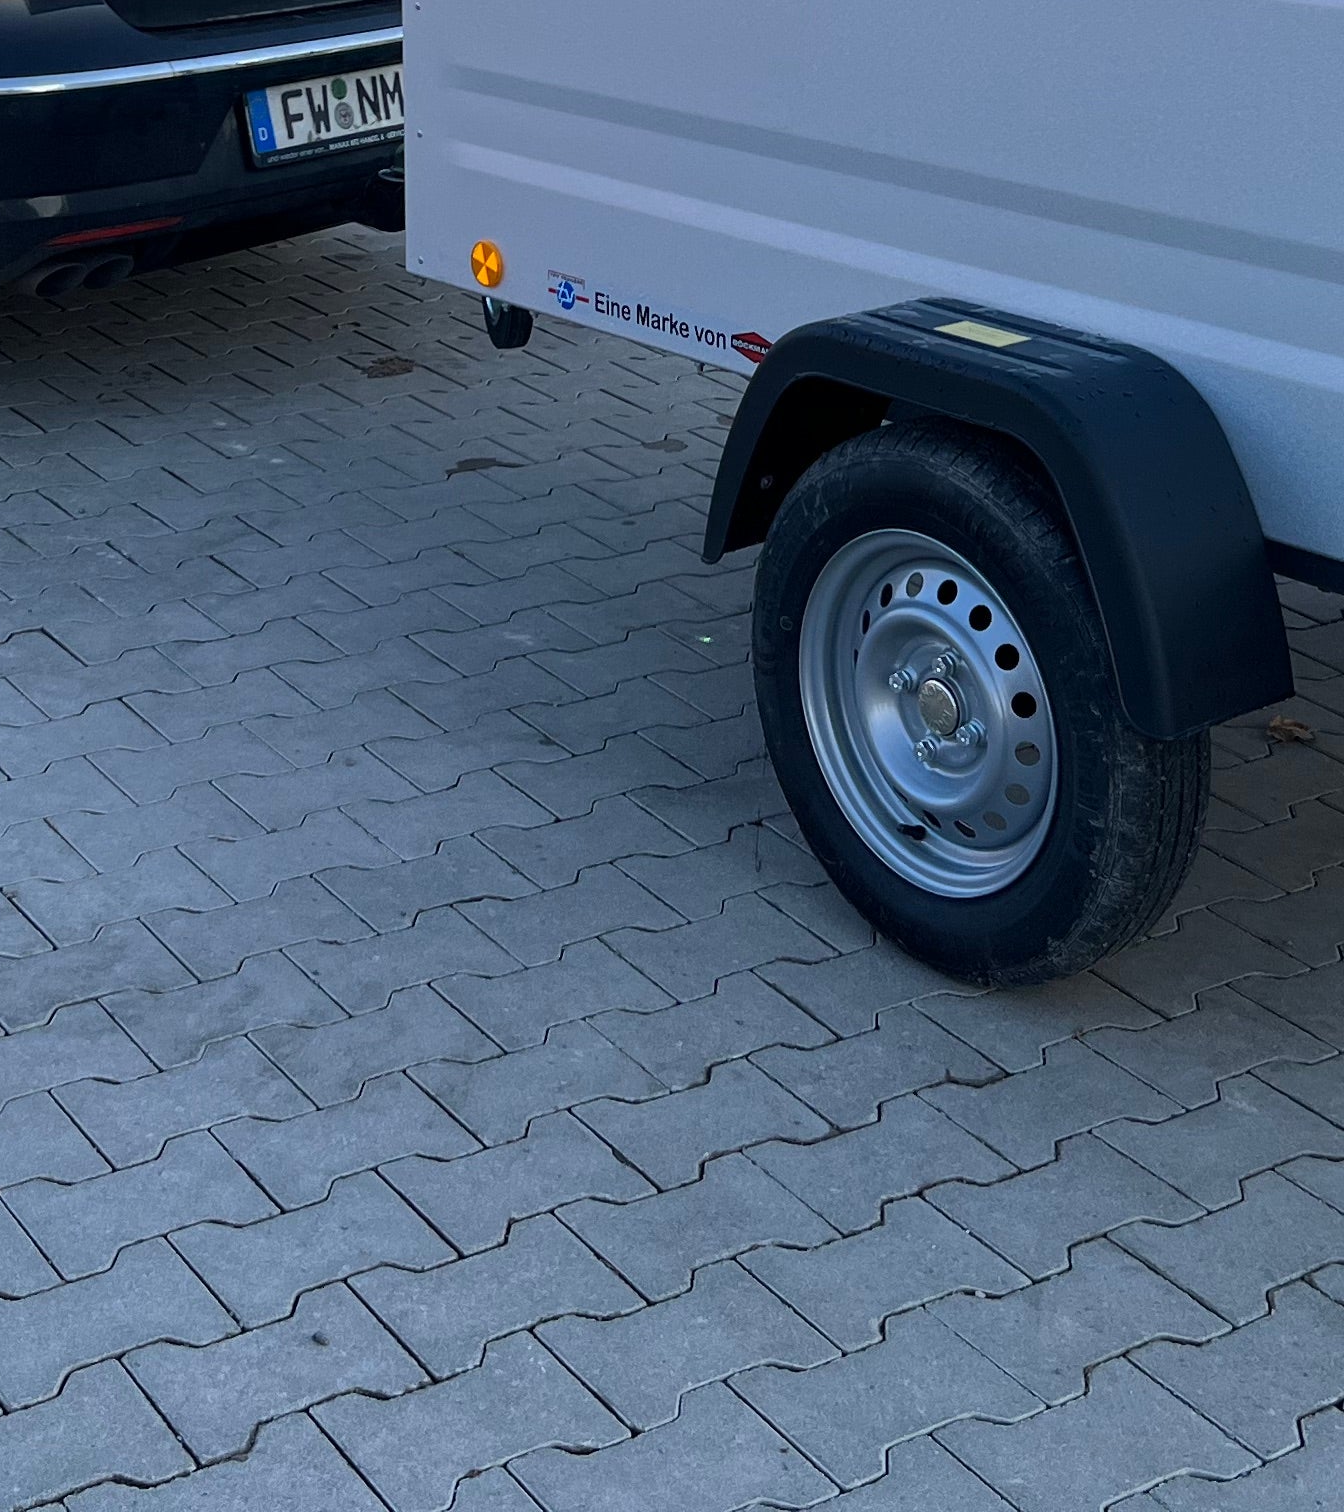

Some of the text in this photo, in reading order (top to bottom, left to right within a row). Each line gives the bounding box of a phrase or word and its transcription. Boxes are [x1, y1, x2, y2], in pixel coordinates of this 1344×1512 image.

[281, 71, 404, 140] FW NM
[594, 292, 769, 354] Eine Marke von BÖCKMA
